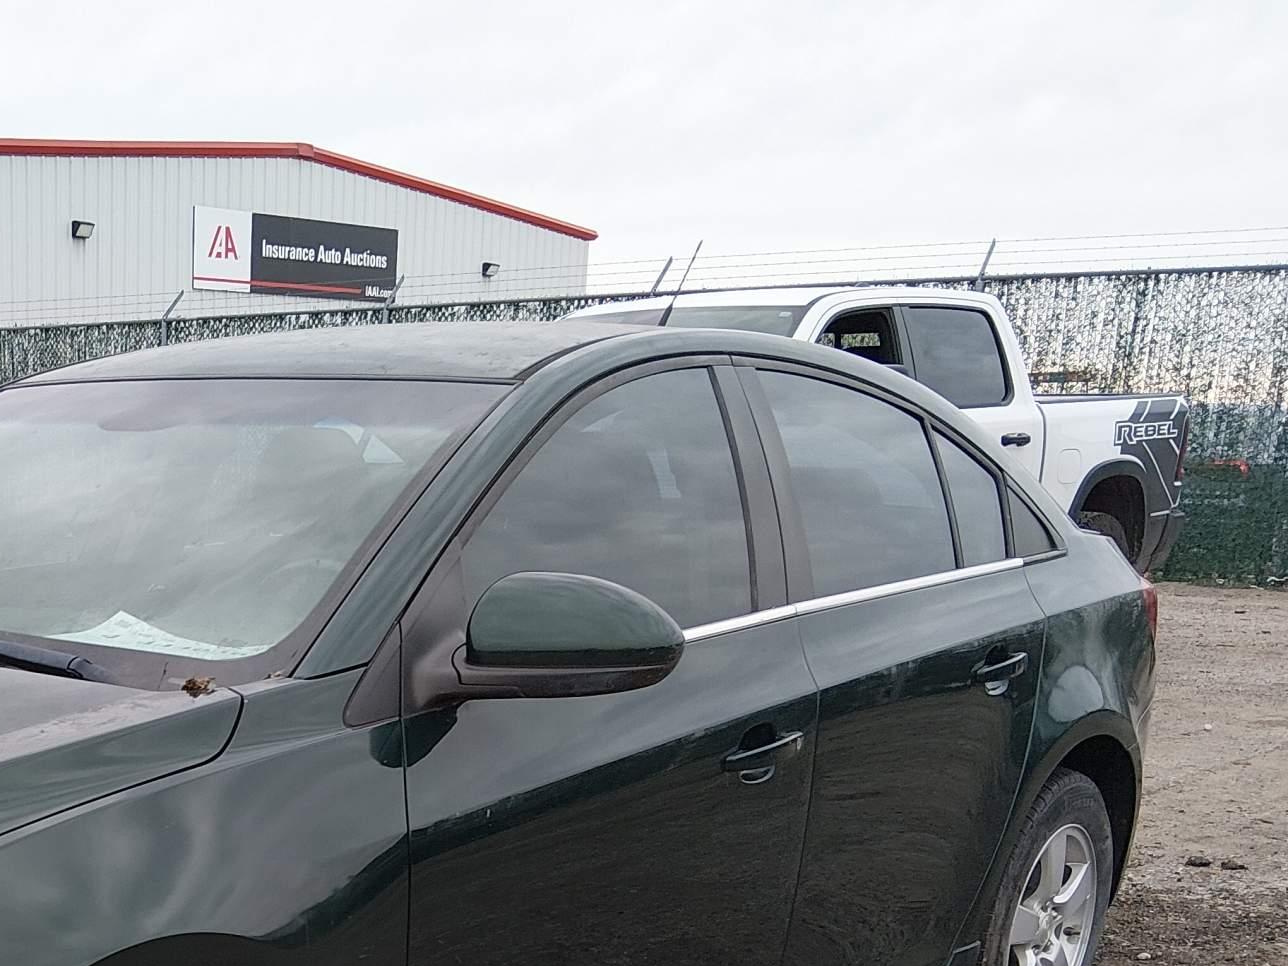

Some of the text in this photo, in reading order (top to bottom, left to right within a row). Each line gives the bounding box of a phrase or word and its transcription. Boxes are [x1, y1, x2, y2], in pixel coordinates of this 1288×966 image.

[262, 239, 387, 269] Insurance Auto Auctions
[1115, 422, 1178, 445] REBEL
